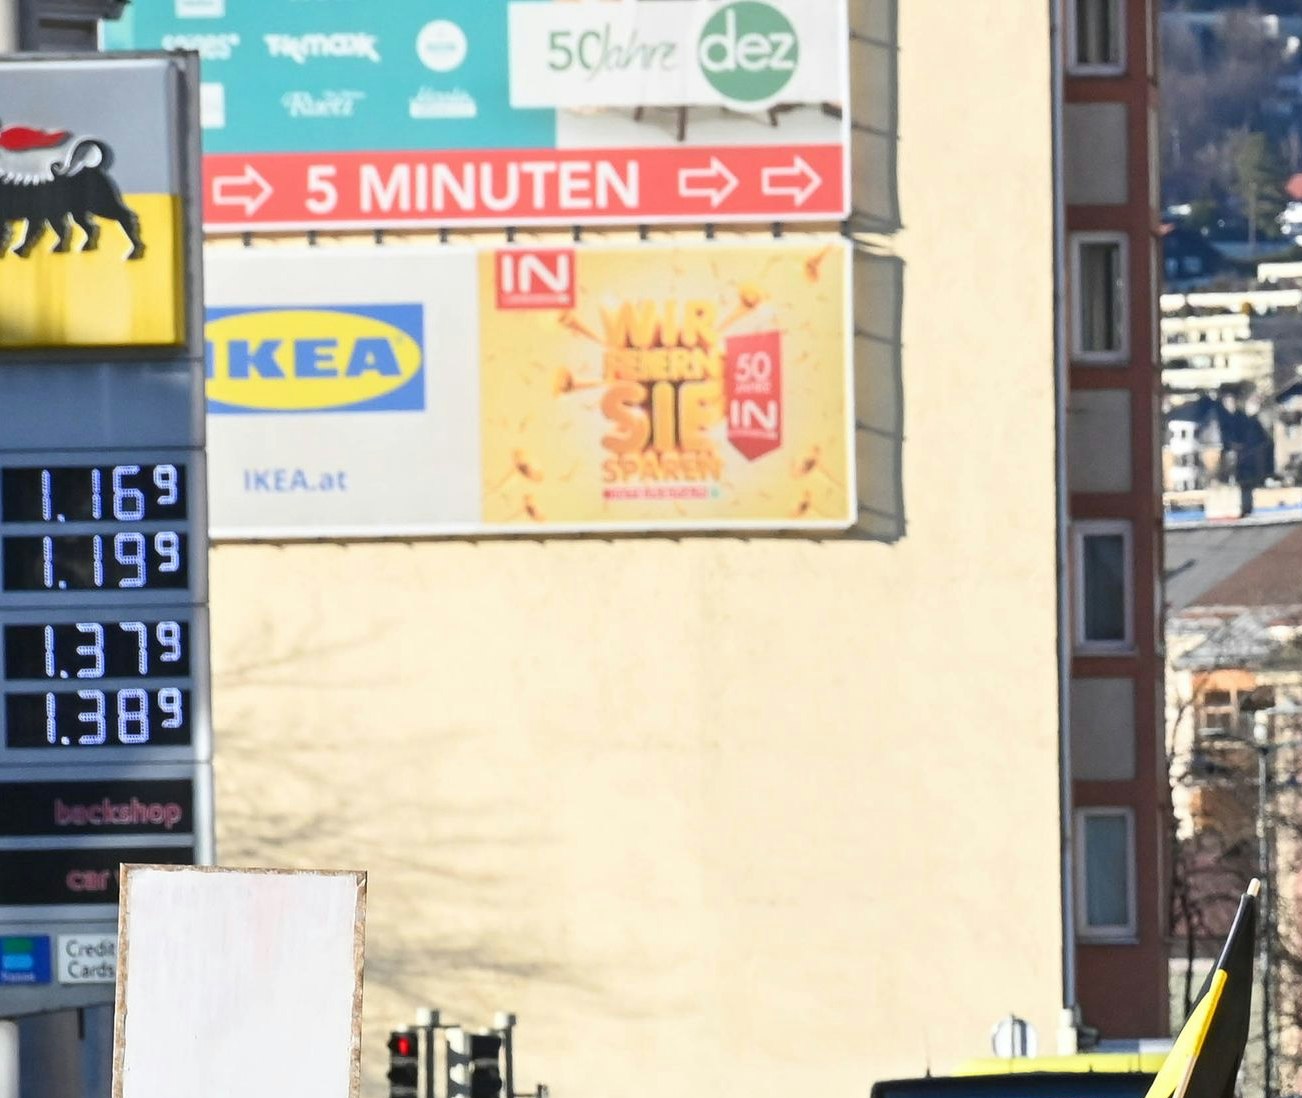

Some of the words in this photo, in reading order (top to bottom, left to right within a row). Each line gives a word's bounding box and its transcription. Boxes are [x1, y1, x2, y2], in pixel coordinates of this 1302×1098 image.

[548, 31, 601, 72] 50
[699, 8, 797, 72] dez
[306, 166, 337, 214] 5
[360, 161, 640, 213] MINUTEN
[502, 254, 570, 293] IN
[602, 300, 717, 349] WIR
[735, 352, 773, 382] 50
[602, 380, 726, 453] SIE
[730, 401, 778, 430] IN
[243, 468, 348, 491] IKEA.at
[603, 450, 725, 483] SPAREN
